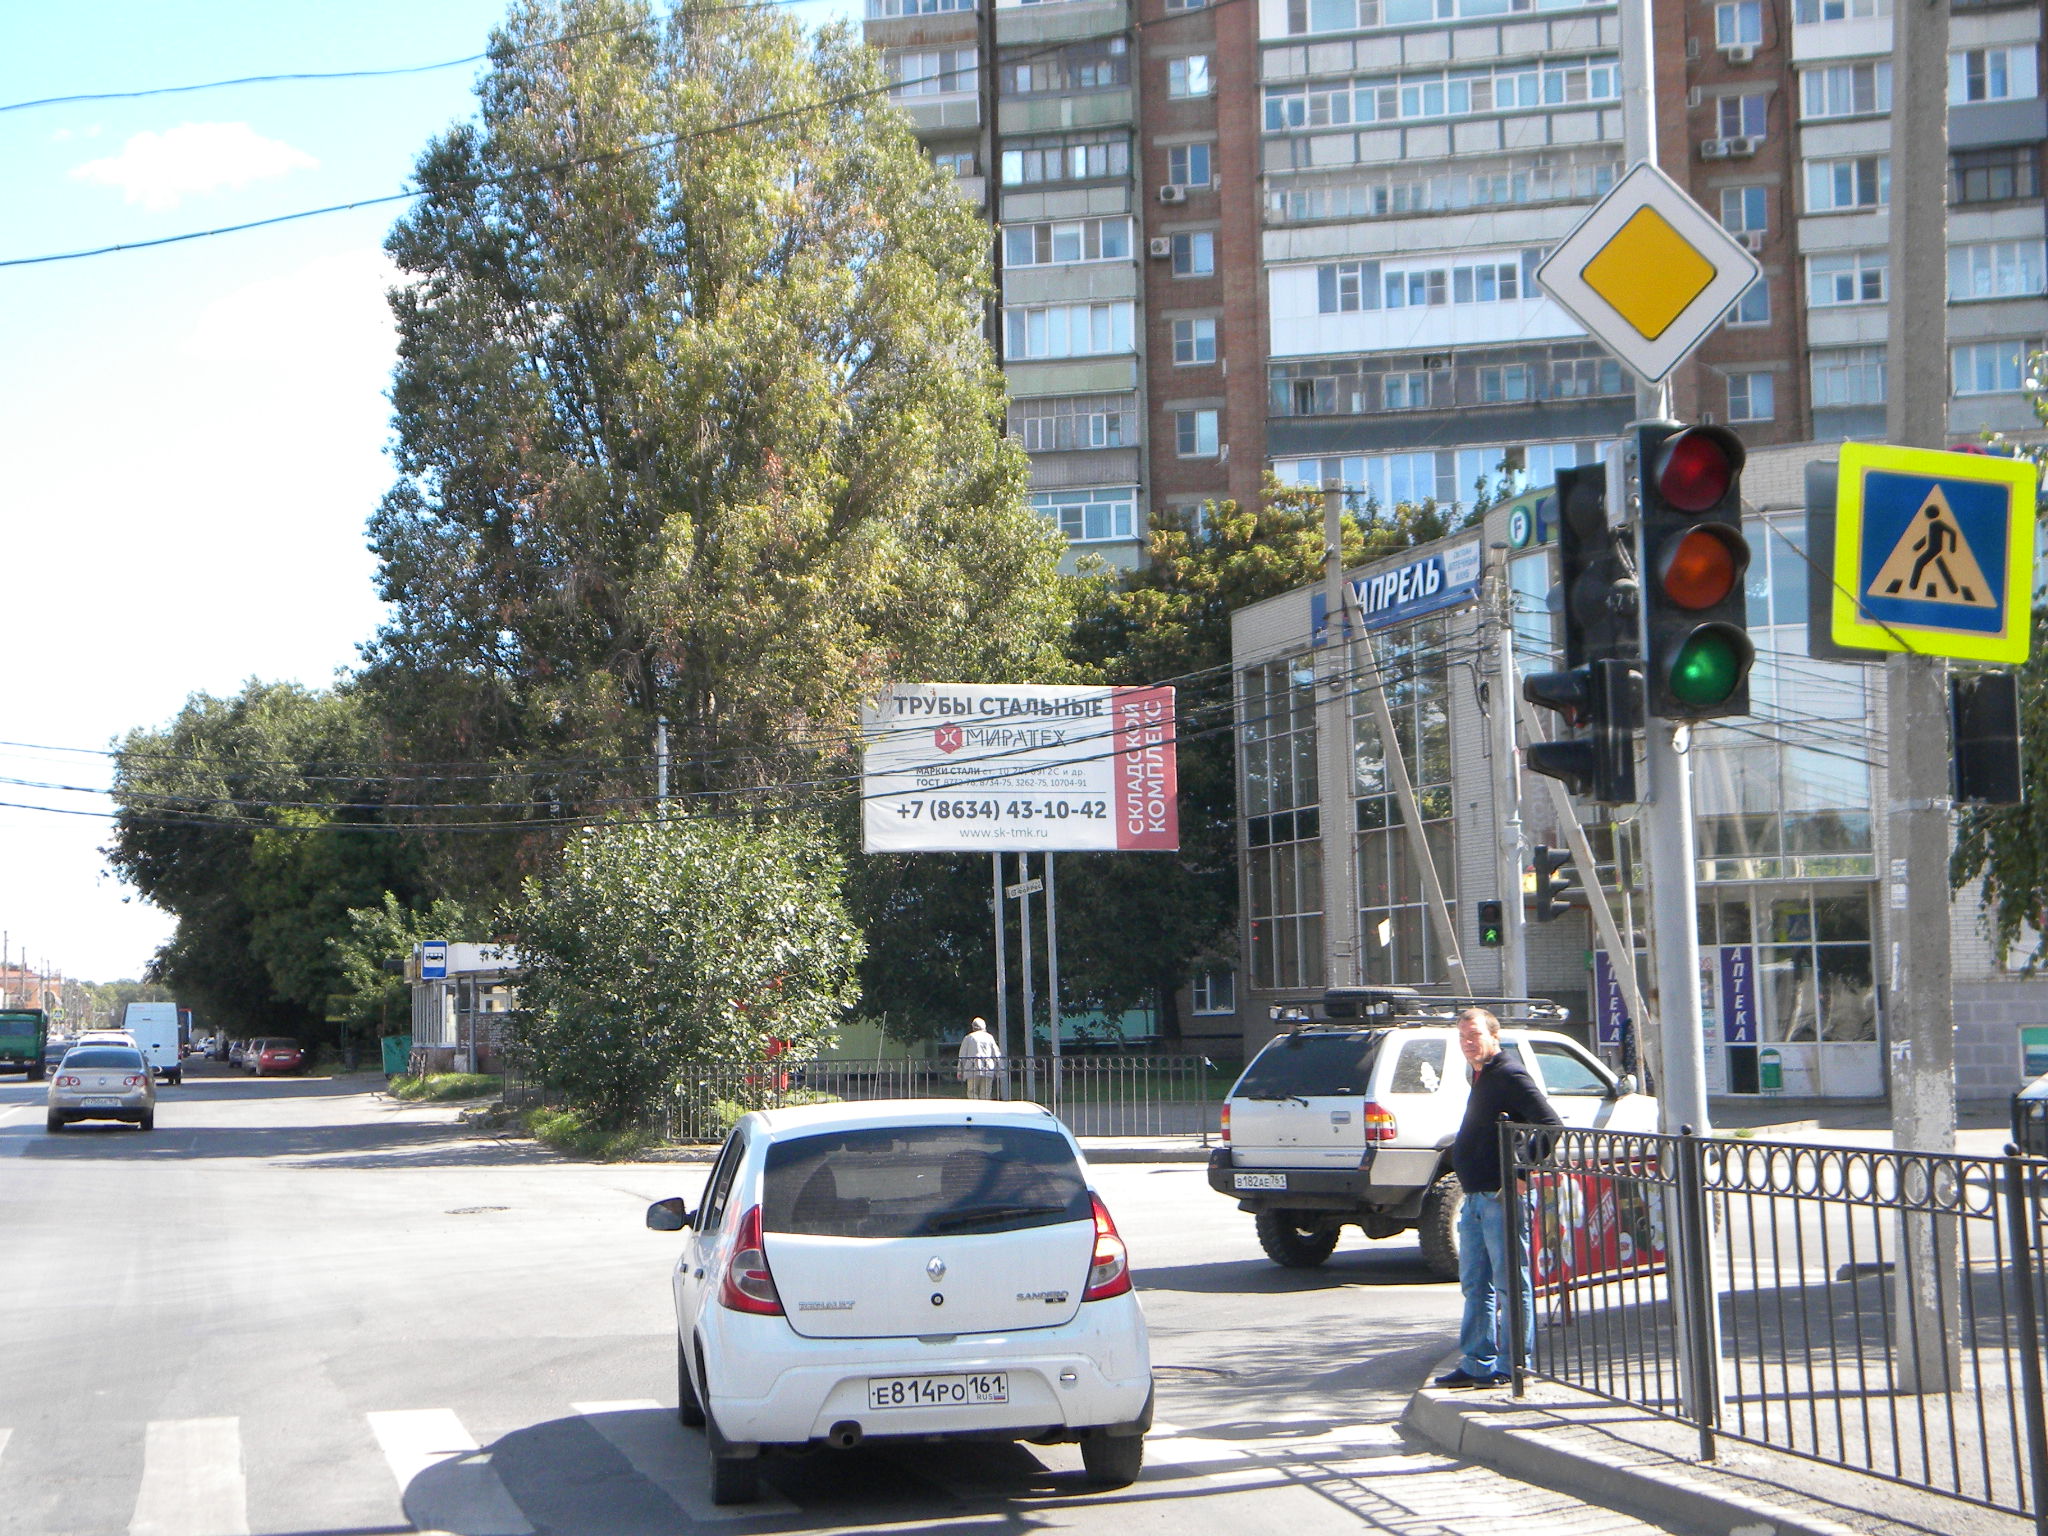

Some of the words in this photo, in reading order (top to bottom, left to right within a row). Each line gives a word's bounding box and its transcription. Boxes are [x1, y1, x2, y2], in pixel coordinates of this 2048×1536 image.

[1357, 558, 1440, 615] АПРЕЛЬ
[893, 697, 972, 715] ТРУБЫ
[979, 697, 1104, 717] СТАЛЬНЫЕ
[966, 729, 1066, 747] МИРАТЕХ
[916, 767, 948, 776] МАРКИ
[950, 767, 980, 775] СТАЛИ
[1121, 702, 1144, 835] СКЛАДСКОЙ
[1143, 700, 1166, 833] КОМПЛЕКС
[916, 778, 939, 787] ГОСТ
[1051, 779, 1087, 788] 10704-91
[897, 800, 924, 819] +7
[929, 799, 1000, 821] (8634)
[1006, 800, 1107, 819] 43-10-42
[959, 826, 1048, 838] www.sk-tmk.ru
[1731, 948, 1747, 1041] АПТЕКА
[876, 1379, 966, 1405] Е814РО
[969, 1375, 1002, 1394] 161
